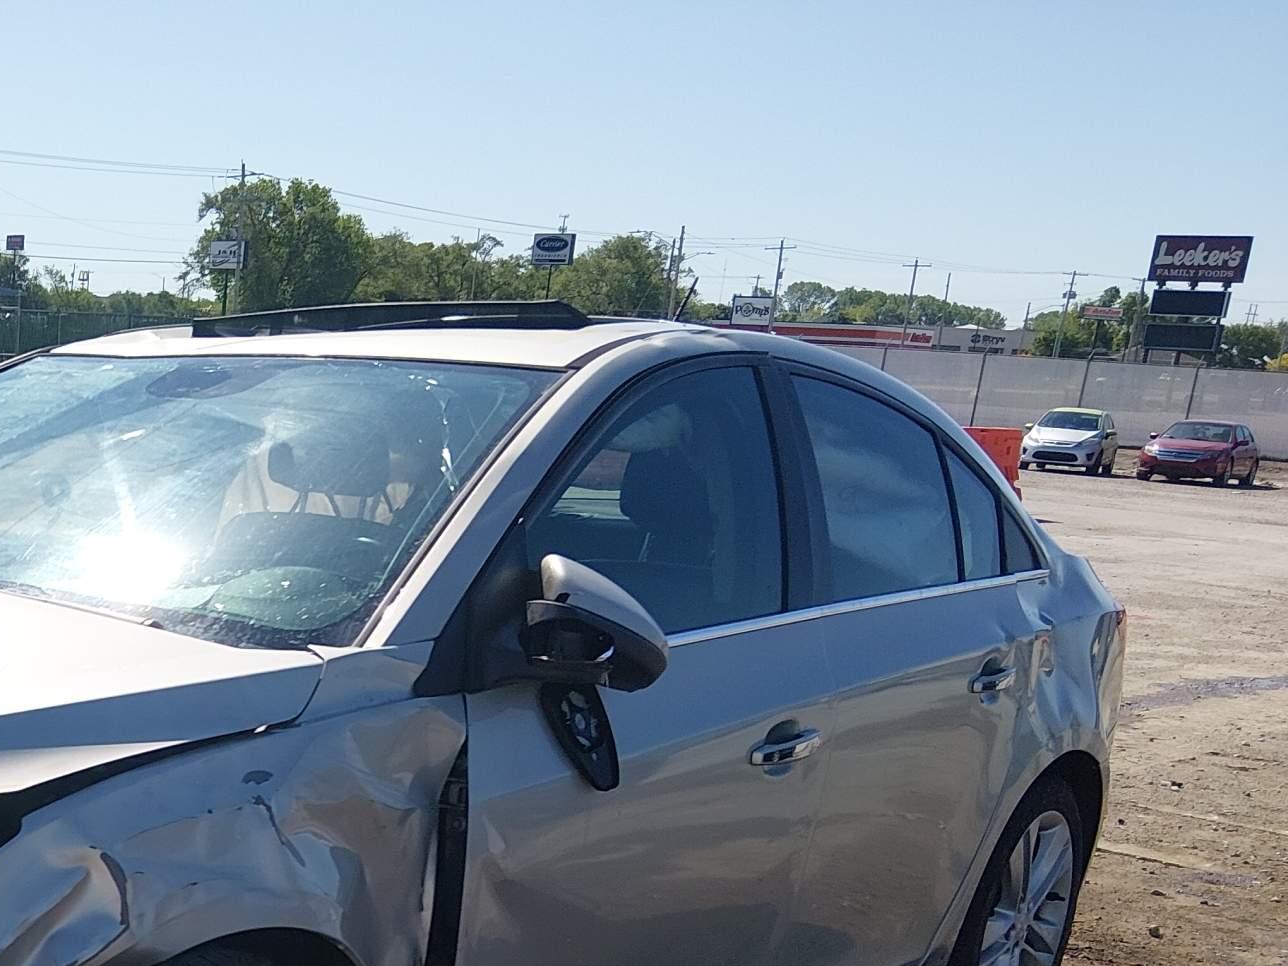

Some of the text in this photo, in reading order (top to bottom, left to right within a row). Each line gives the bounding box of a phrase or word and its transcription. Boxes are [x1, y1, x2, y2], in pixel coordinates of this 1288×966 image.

[1154, 241, 1244, 267] Leeker's
[1156, 269, 1234, 278] FAMILY FOODS
